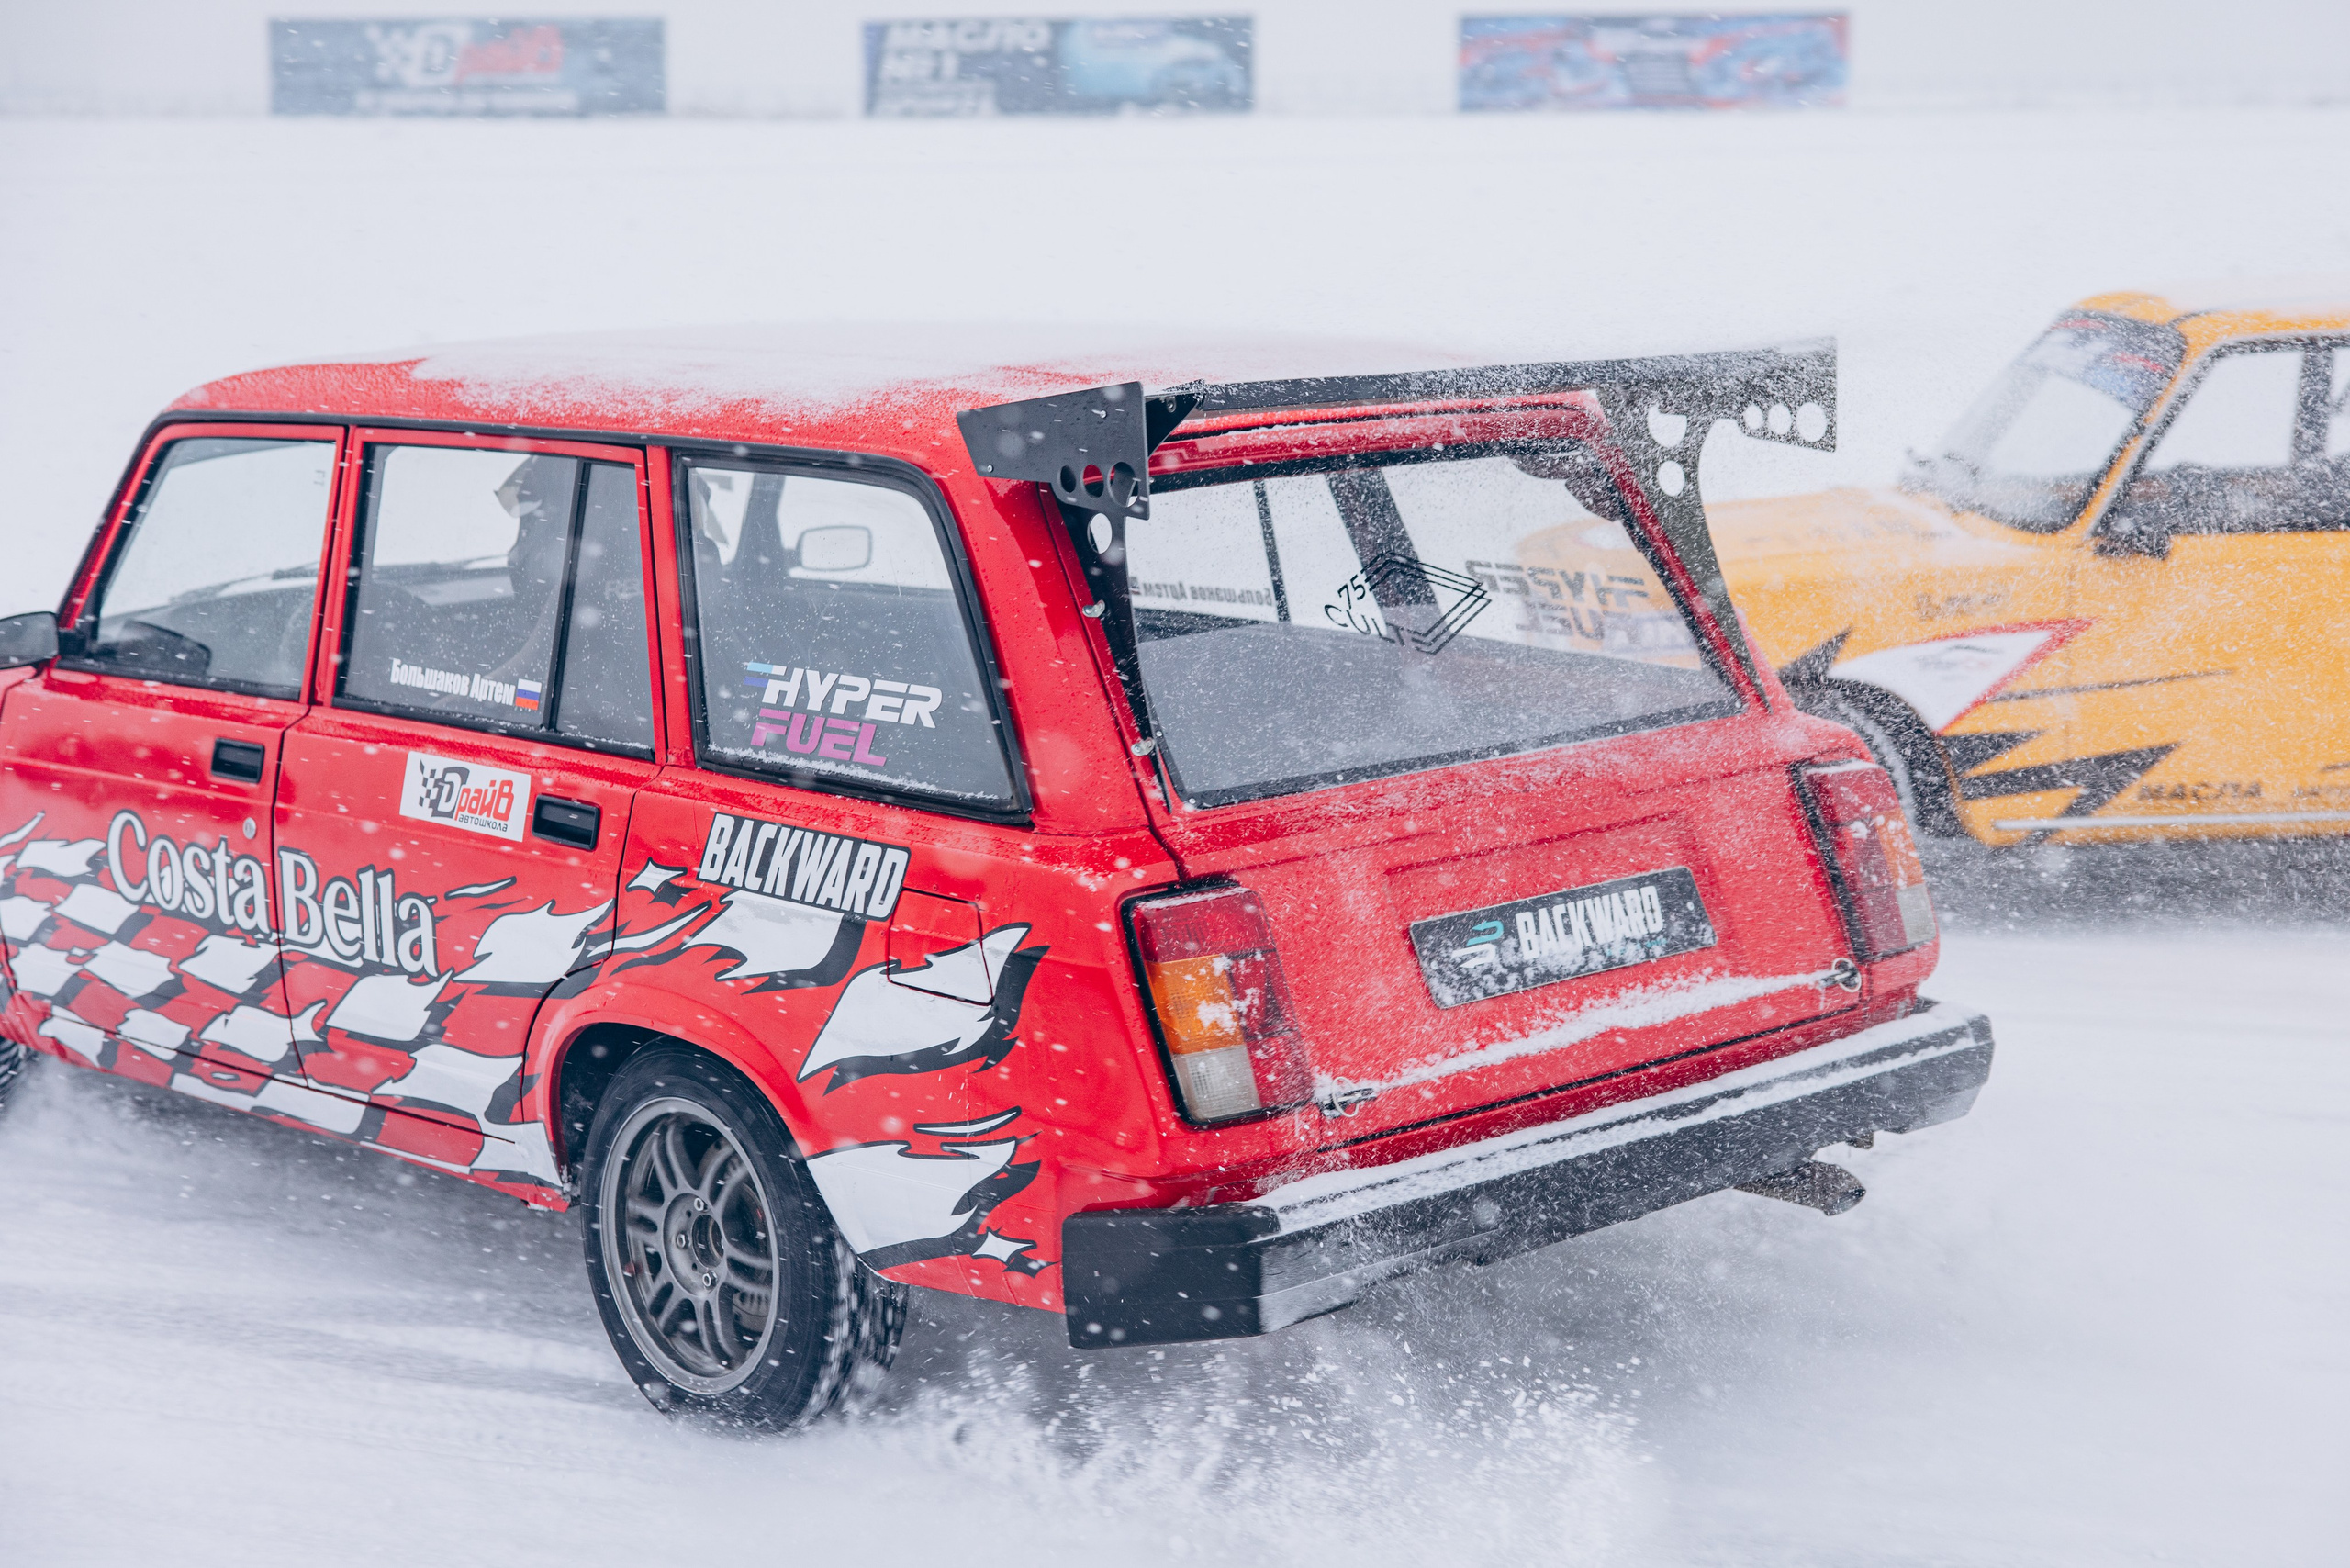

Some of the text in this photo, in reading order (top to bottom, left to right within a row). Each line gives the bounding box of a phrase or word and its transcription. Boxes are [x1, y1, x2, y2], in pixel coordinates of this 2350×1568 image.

[390, 657, 516, 706] Большаков Артем
[744, 662, 943, 728] HYPER
[750, 708, 887, 767] FUEL
[458, 814, 509, 833] автошкола
[106, 809, 440, 978] Costa Bella
[699, 813, 909, 918] BACKWARD
[1516, 886, 1663, 961] BACKWARD
